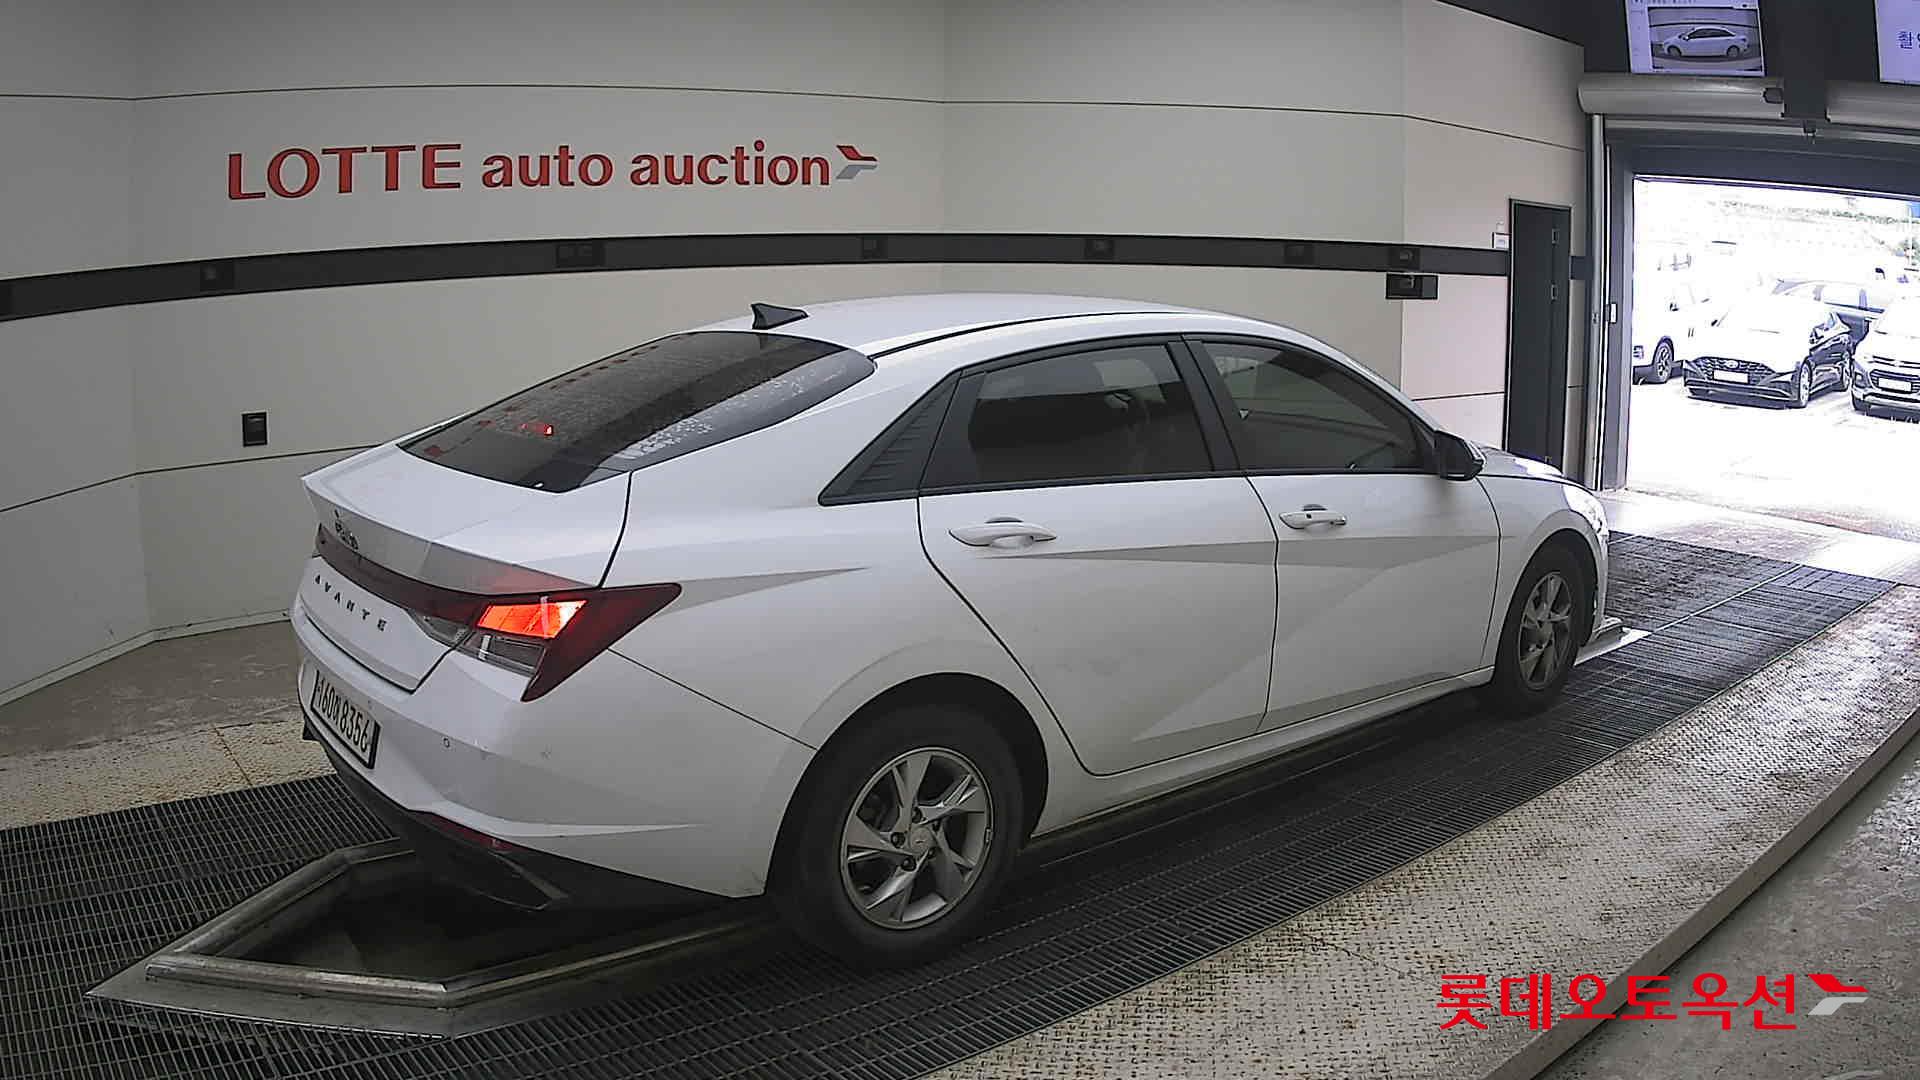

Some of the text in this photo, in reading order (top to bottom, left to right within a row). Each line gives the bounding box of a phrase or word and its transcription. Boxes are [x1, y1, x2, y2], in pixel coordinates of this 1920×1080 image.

[228, 140, 830, 200] LOTTE auto auction
[314, 574, 387, 632] AVANTE
